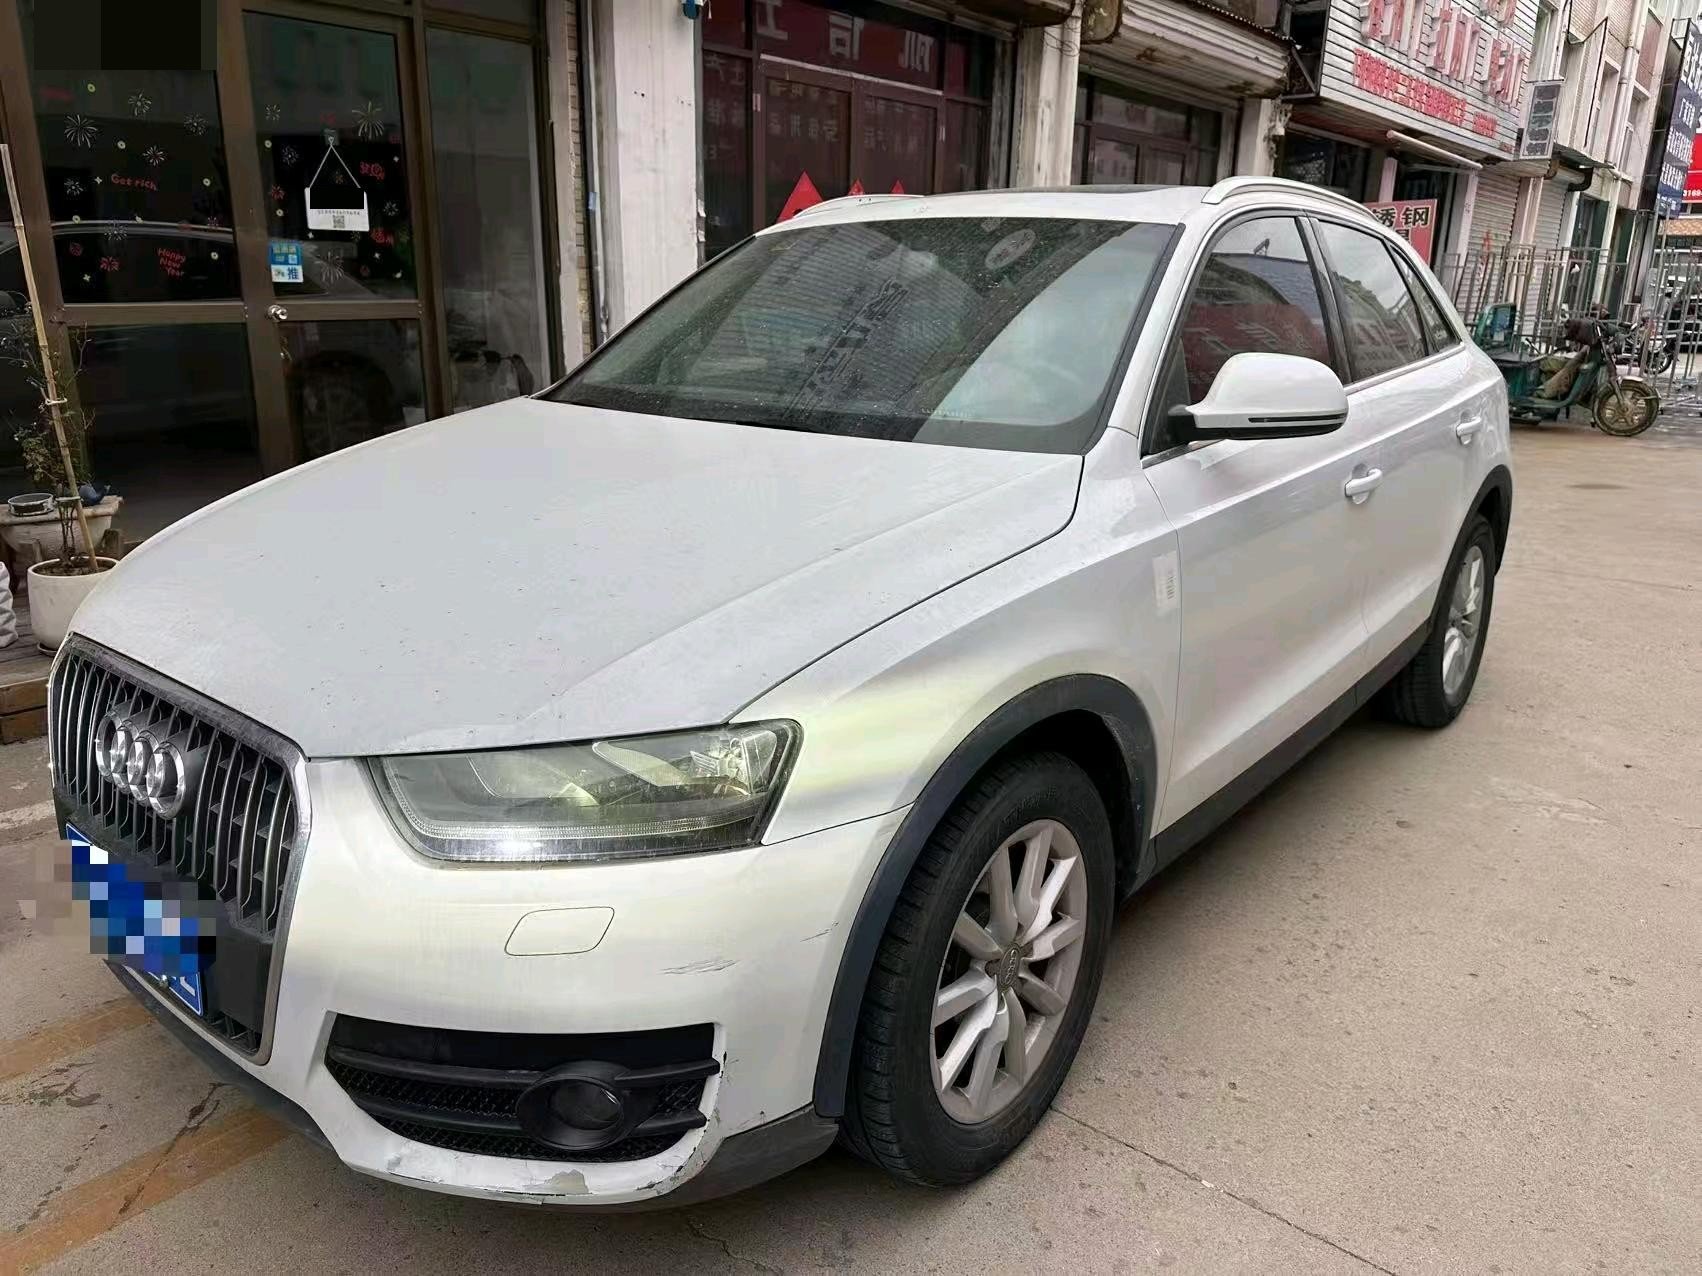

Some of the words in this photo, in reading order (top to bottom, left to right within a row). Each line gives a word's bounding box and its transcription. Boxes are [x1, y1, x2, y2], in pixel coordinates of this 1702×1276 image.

[111, 173, 132, 187] Get
[134, 178, 158, 192] rich
[158, 247, 187, 263] Happy
[159, 257, 181, 269] New
[287, 266, 300, 281] 推
